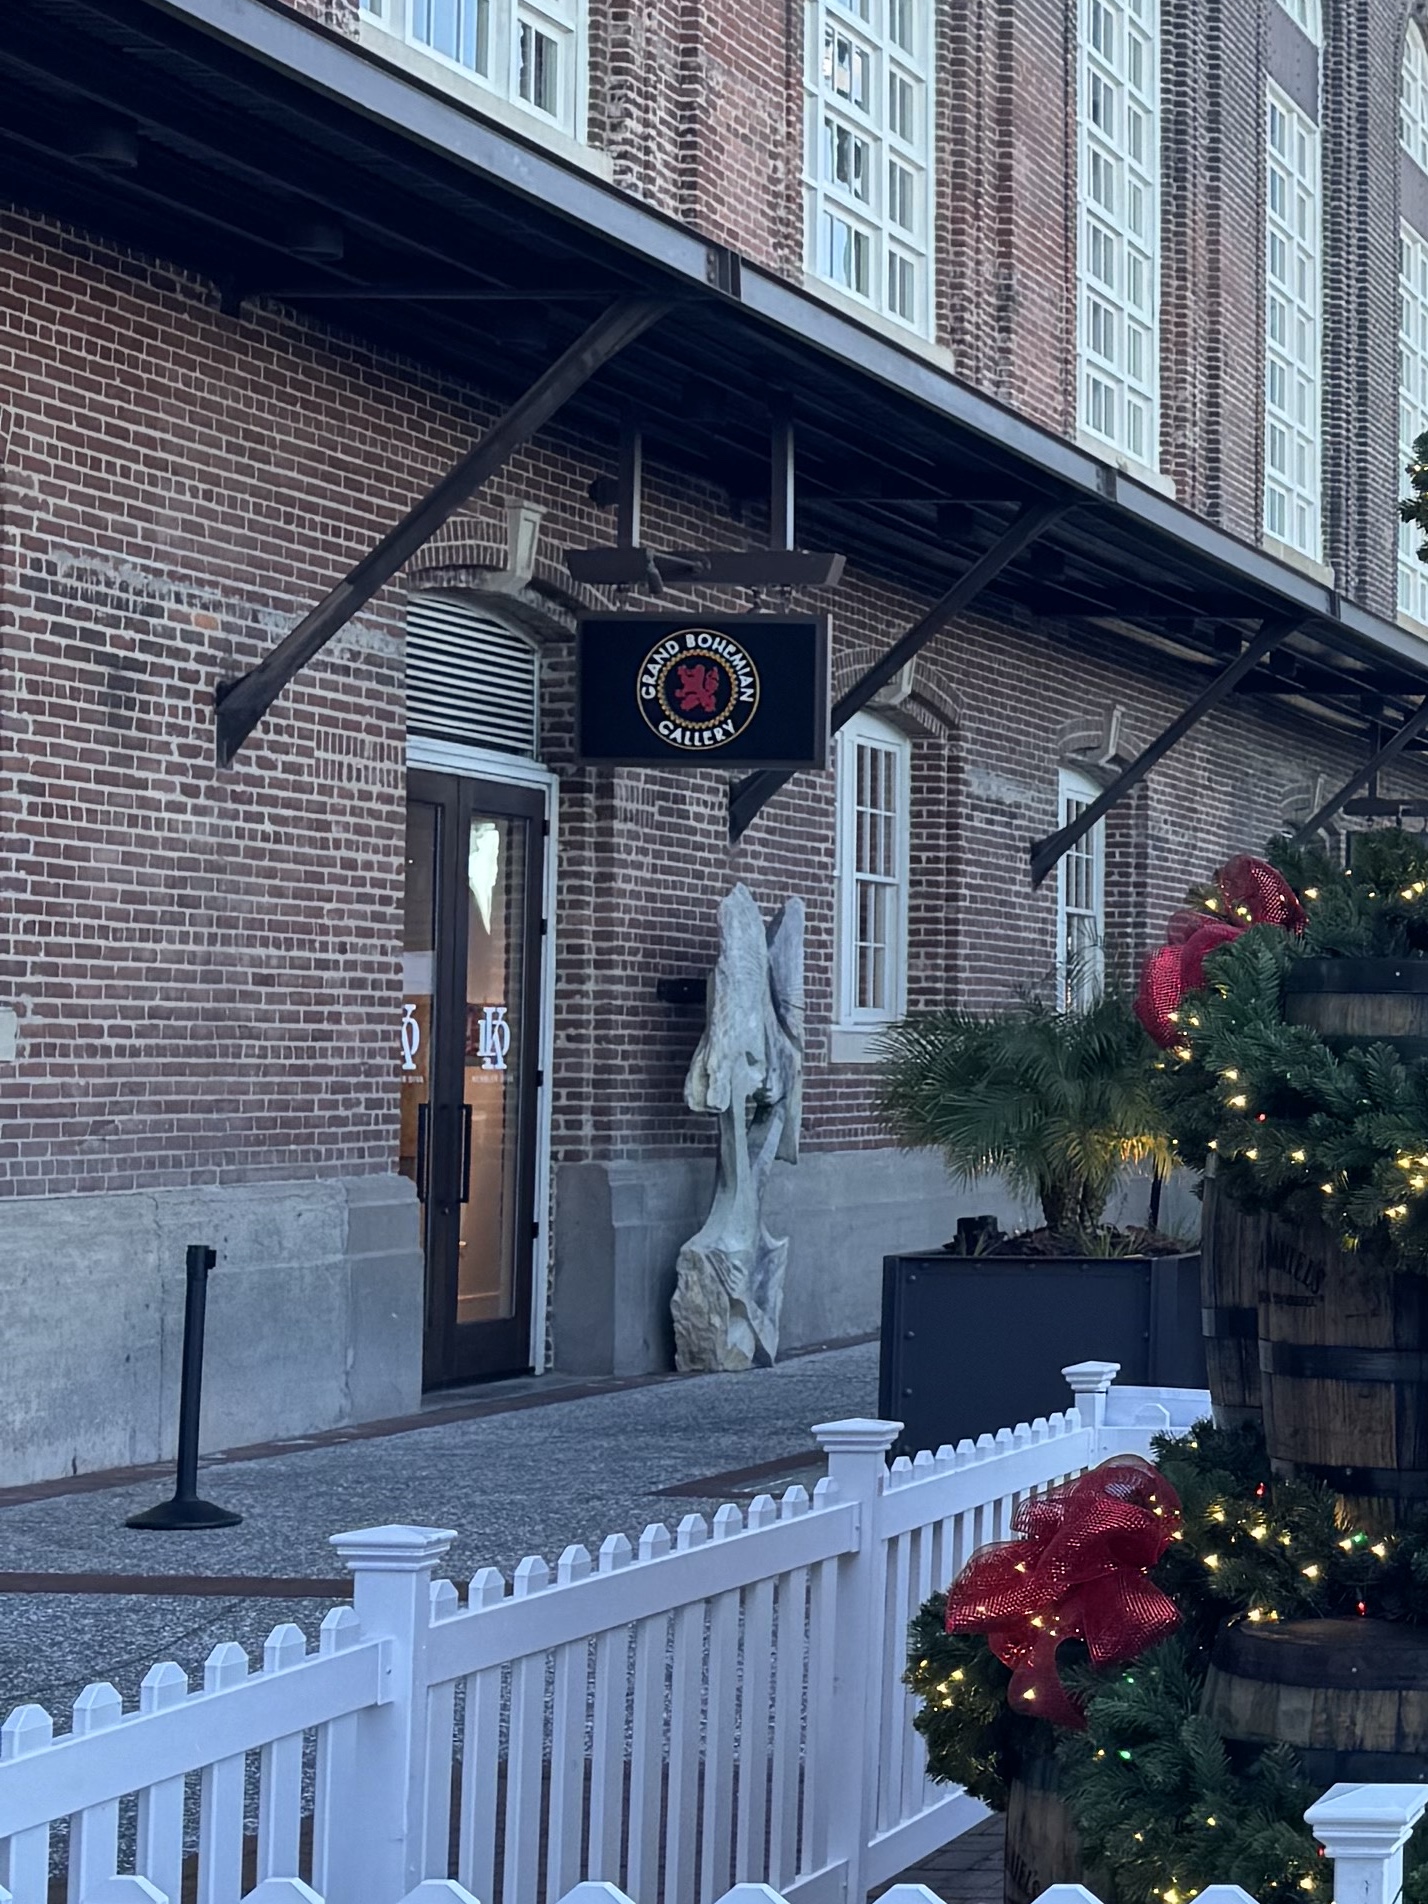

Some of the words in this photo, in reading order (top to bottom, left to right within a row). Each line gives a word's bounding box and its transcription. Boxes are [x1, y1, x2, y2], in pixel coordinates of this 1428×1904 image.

[640, 640, 680, 700] GRAND
[685, 632, 755, 703] BOHEMIAN
[658, 719, 736, 746] GALLERY
